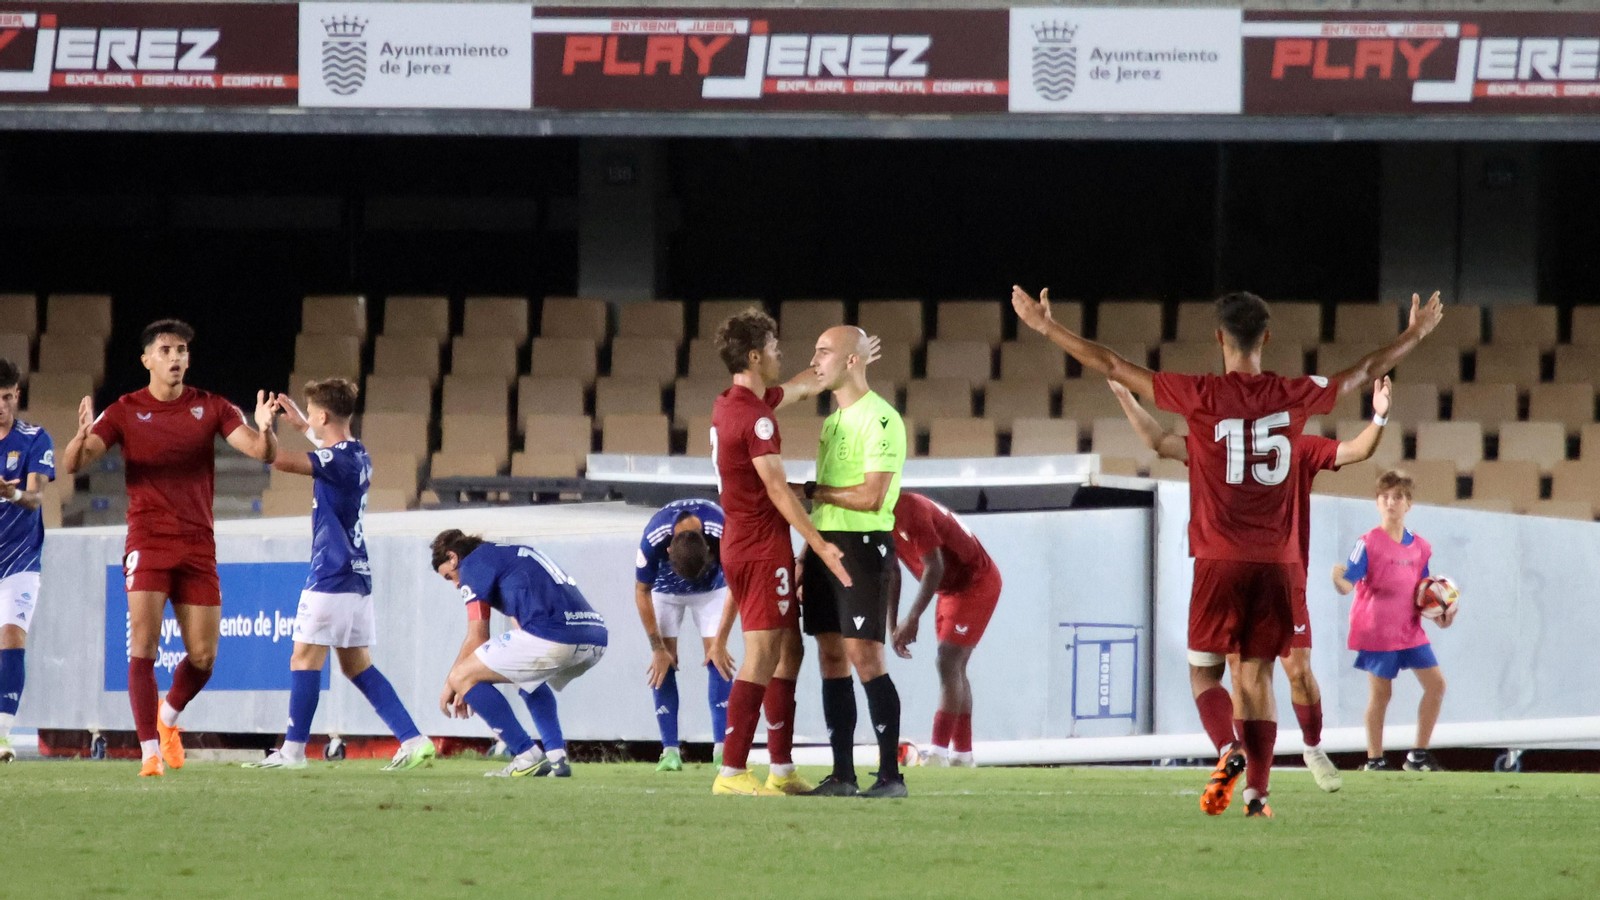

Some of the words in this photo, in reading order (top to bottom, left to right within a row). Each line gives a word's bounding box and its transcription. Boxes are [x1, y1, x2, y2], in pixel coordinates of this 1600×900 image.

[610, 20, 680, 34] ENTRENA,
[379, 41, 509, 59] Ayuntamiento
[1089, 46, 1218, 64] Ayuntamiento
[379, 60, 400, 75] de
[406, 60, 452, 78] Jerez
[1411, 23, 1600, 103] JERE
[1089, 66, 1111, 81] de
[1115, 66, 1162, 83] Jerez
[1214, 410, 1292, 486] 15
[775, 567, 790, 596] 3
[253, 610, 272, 637] de
[1100, 652, 1110, 706] MONDO
